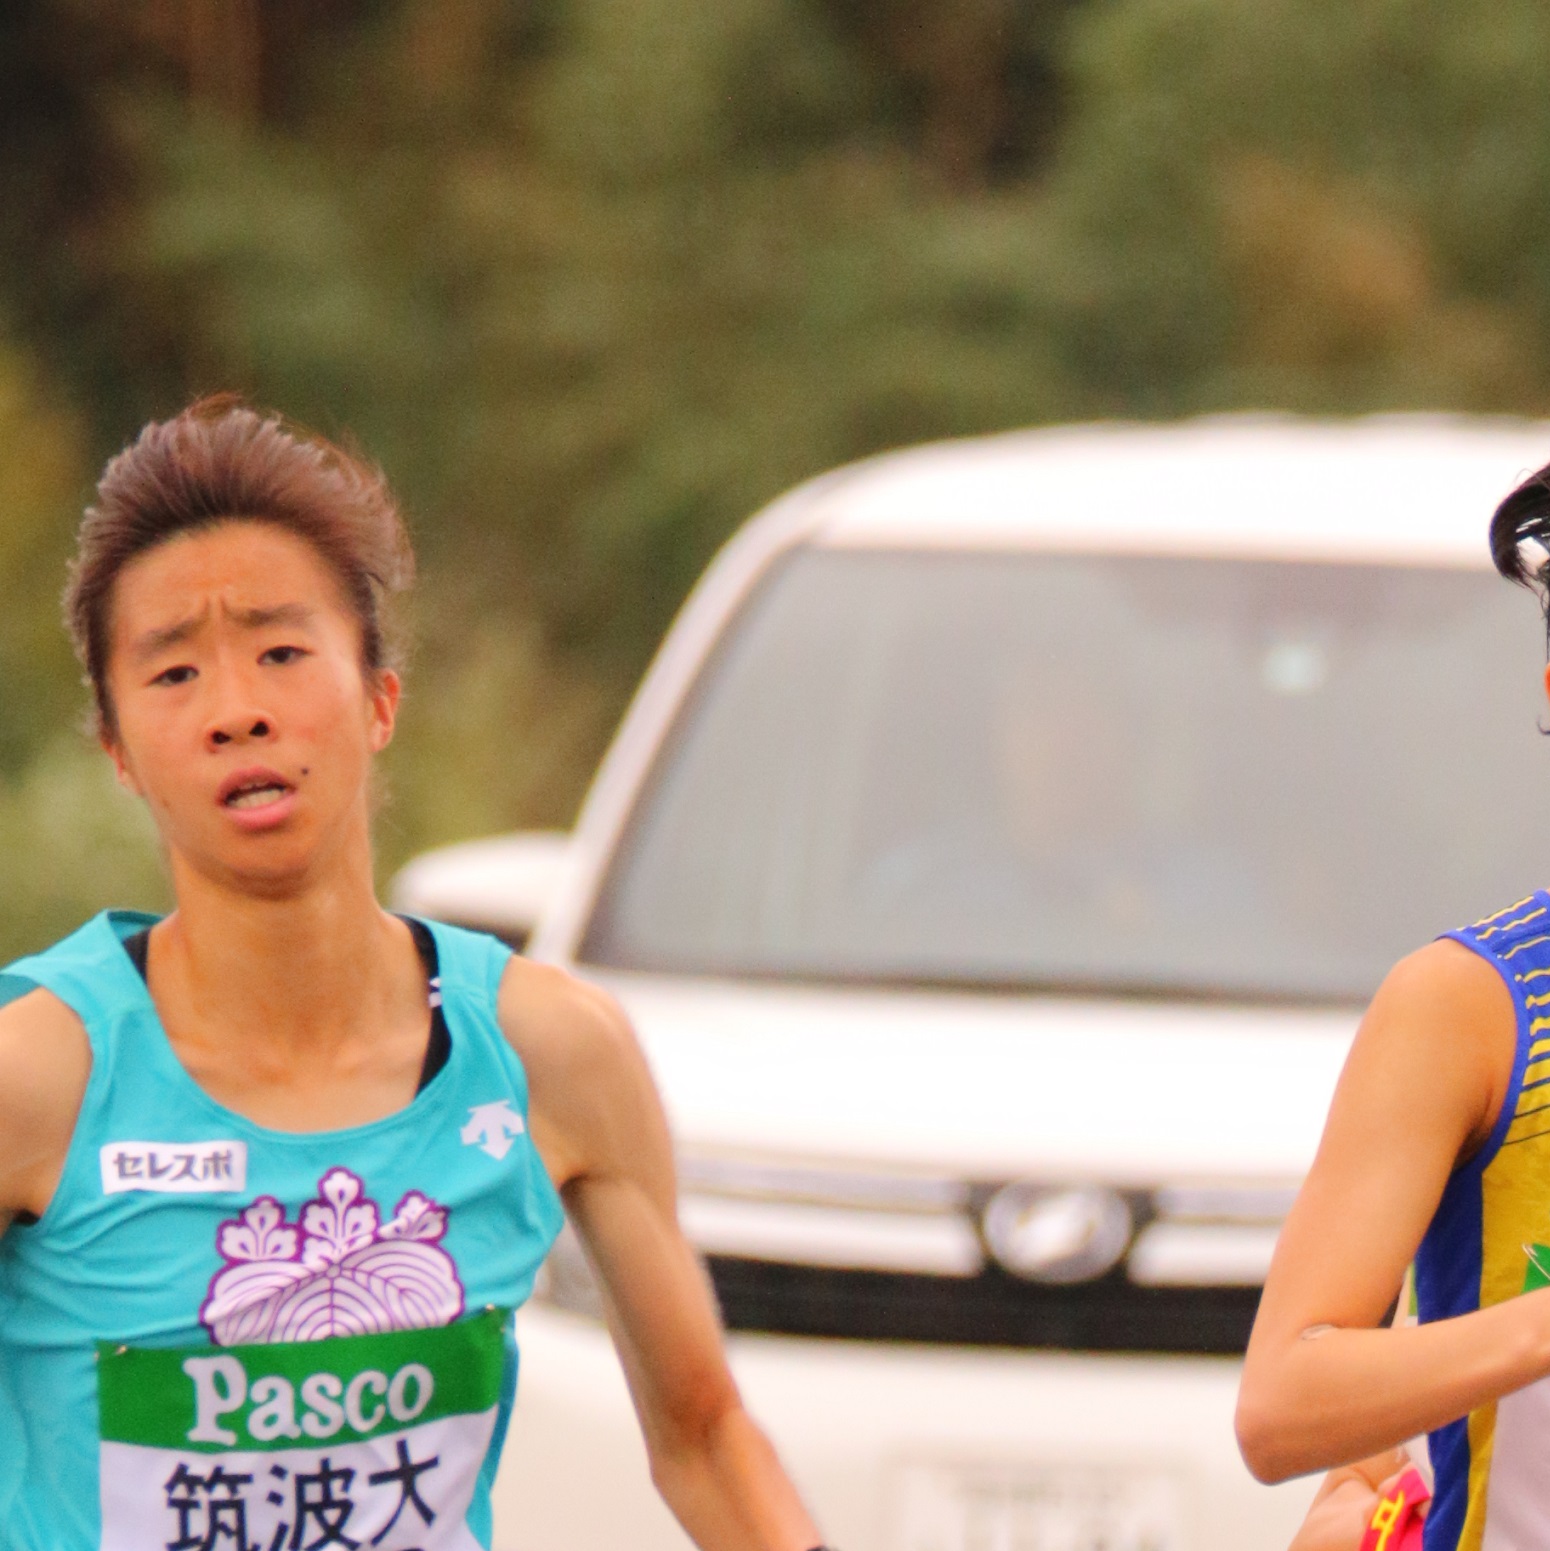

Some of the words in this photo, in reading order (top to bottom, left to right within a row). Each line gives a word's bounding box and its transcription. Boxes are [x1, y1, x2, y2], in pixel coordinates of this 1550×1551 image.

[113, 1149, 232, 1182] セレスポ
[182, 1354, 434, 1447] Pasco
